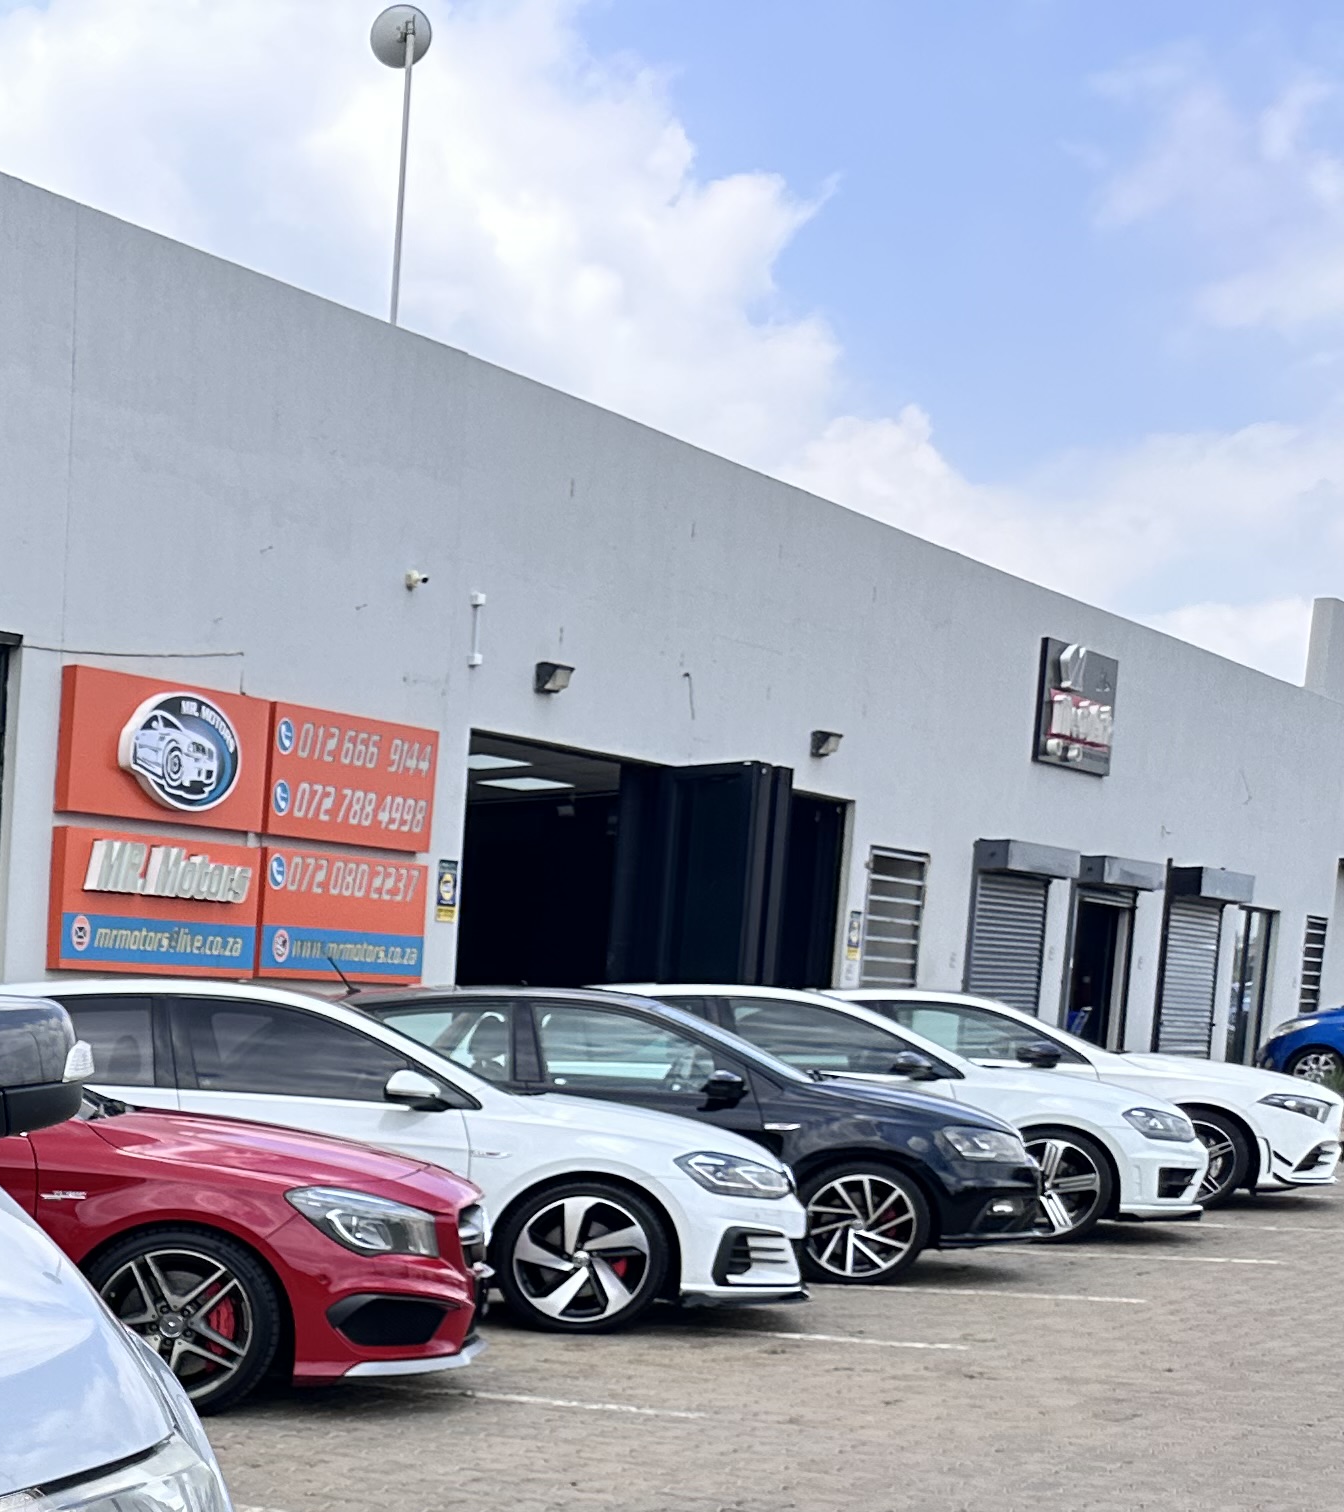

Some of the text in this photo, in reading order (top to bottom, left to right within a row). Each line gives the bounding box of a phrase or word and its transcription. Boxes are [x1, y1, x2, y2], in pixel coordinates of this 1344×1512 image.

[200, 705, 236, 754] MOTORS
[298, 723, 432, 777] 012 666 9144
[293, 782, 427, 833] 072 788 4998
[142, 846, 252, 904] Motors
[286, 855, 328, 893] 072
[329, 861, 369, 898] 080
[369, 866, 420, 902] 2237
